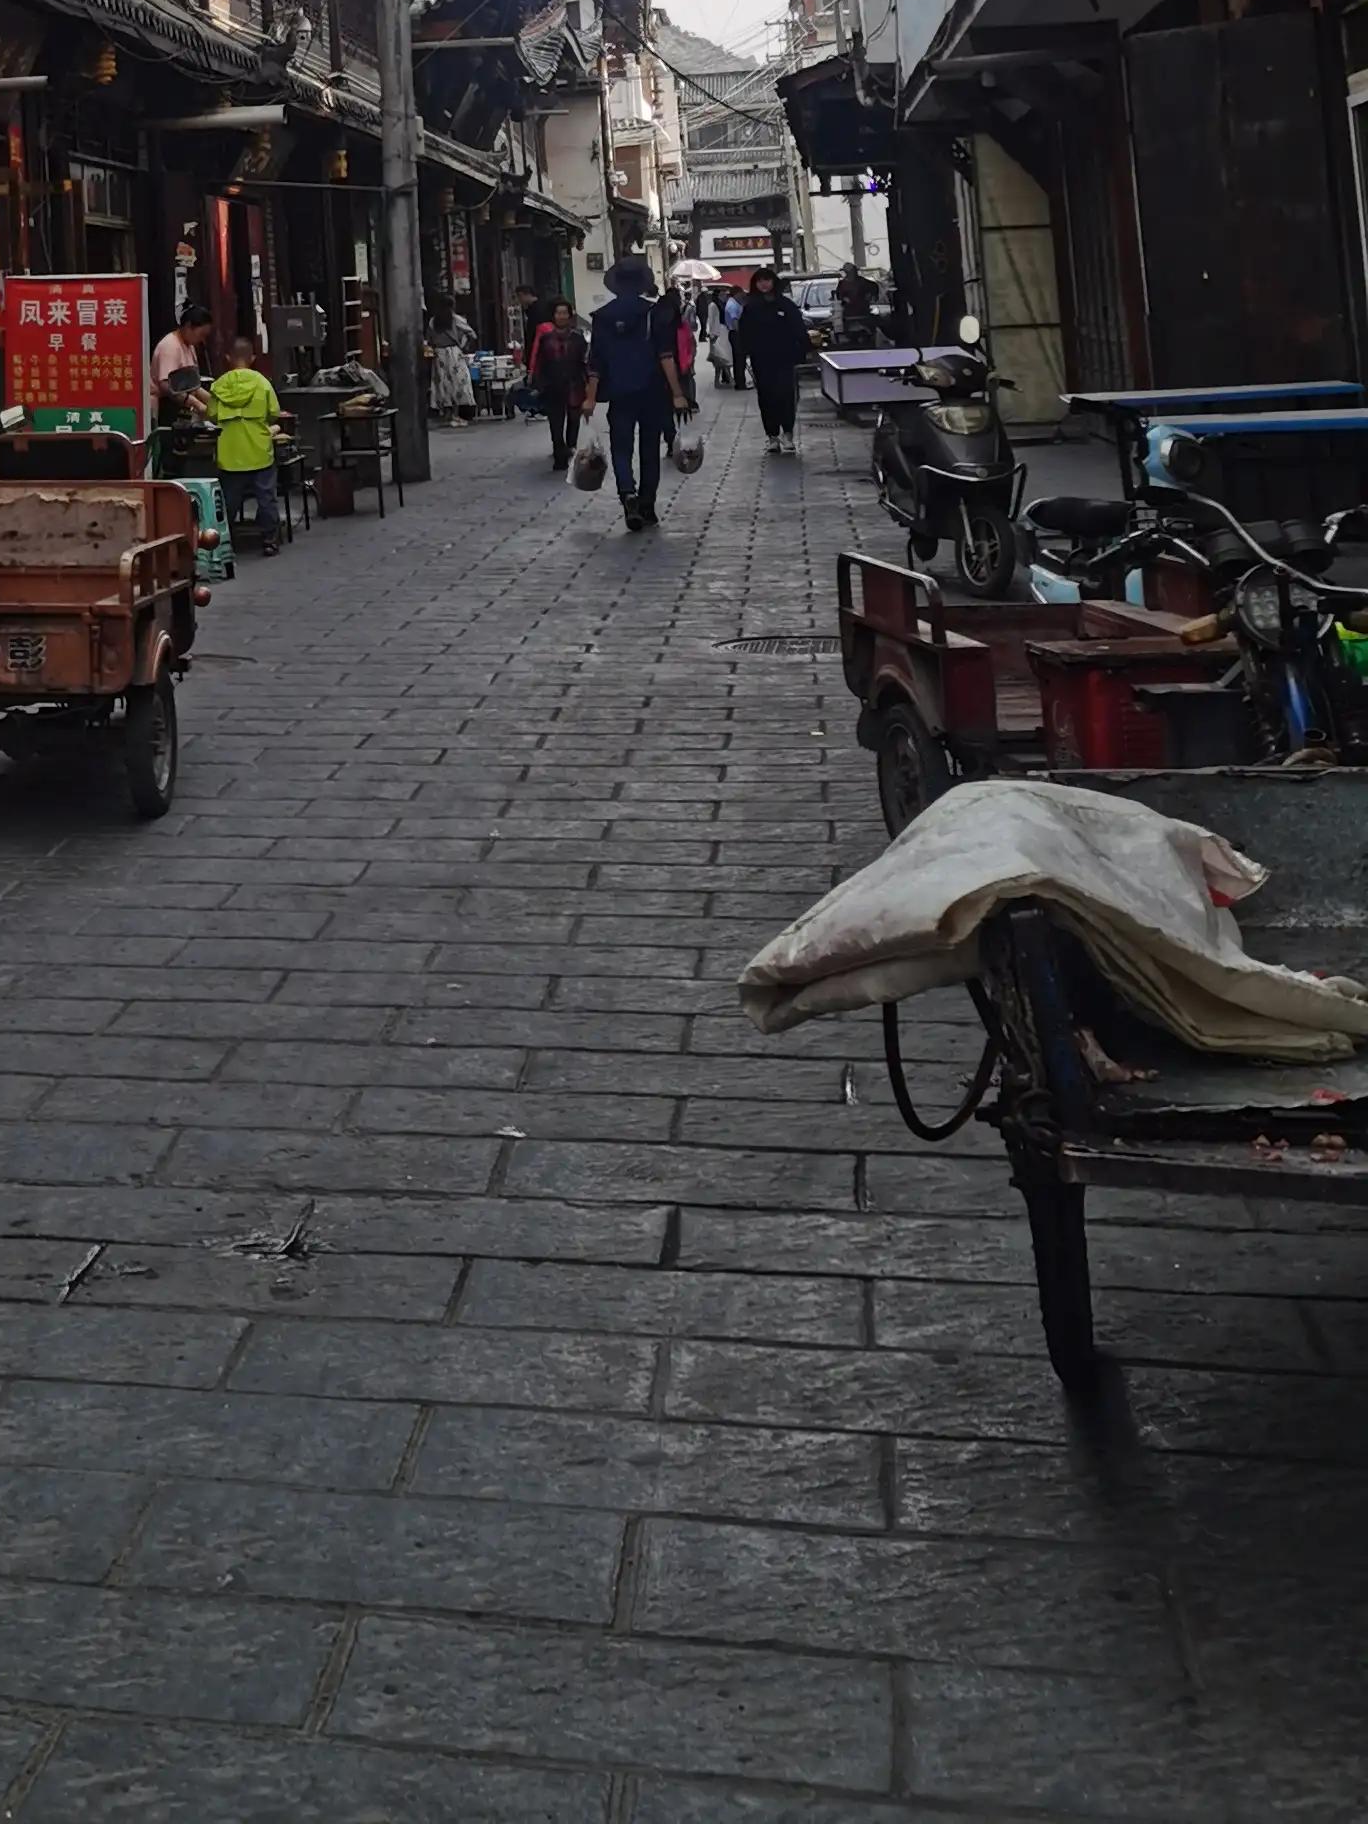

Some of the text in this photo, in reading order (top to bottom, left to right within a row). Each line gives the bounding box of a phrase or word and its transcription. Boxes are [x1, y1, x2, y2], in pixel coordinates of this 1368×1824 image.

[19, 298, 128, 327] 凤来冒菜
[48, 332, 97, 352] 早餐
